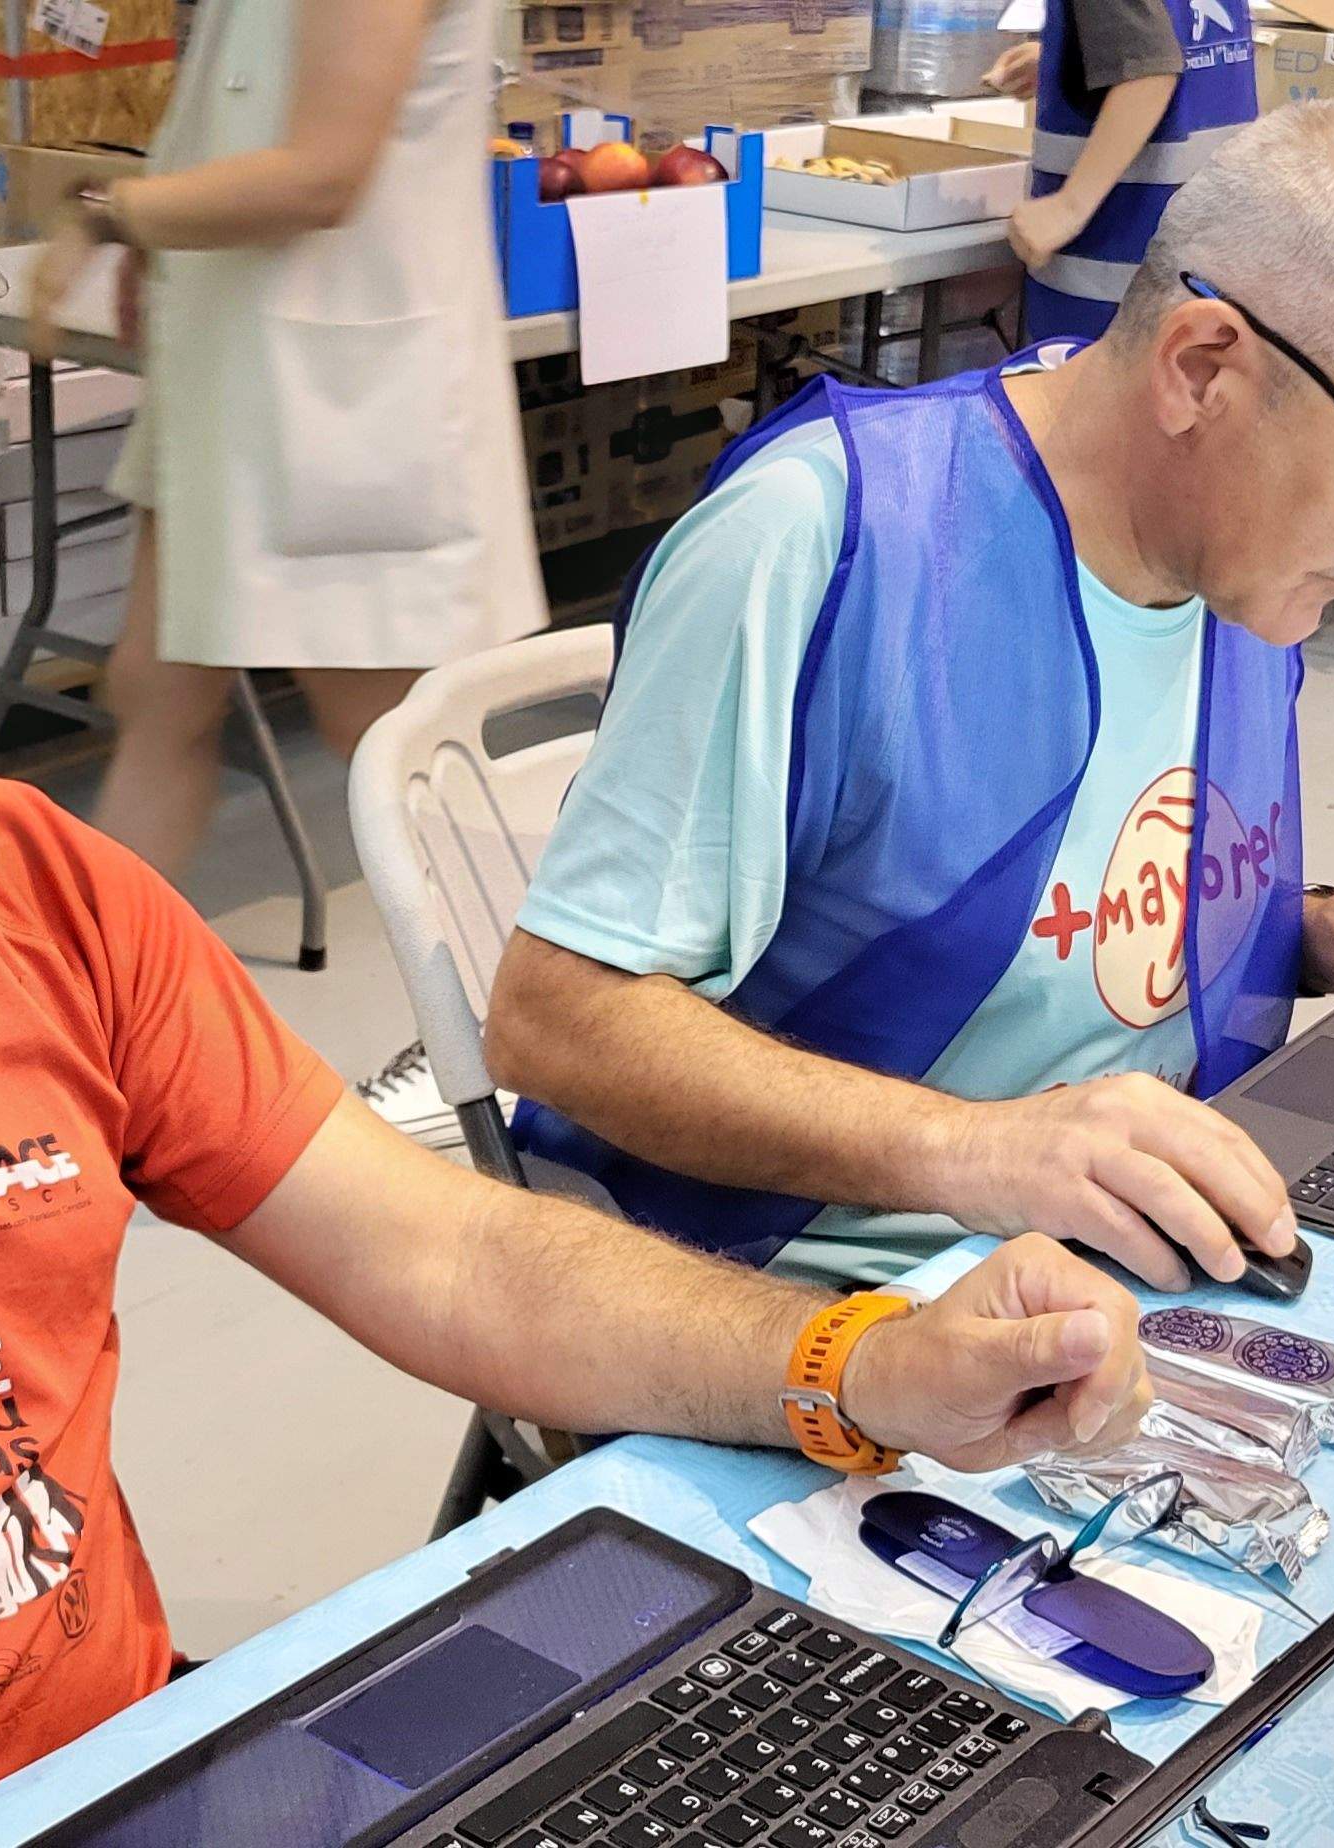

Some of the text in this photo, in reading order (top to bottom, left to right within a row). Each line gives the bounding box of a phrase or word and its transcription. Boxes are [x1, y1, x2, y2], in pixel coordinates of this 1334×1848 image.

[1164, 1324, 1197, 1339] OREO
[1269, 1350, 1302, 1366] OREO
[763, 1681, 782, 1694] Z
[824, 1691, 841, 1703] A
[728, 1706, 747, 1719] X
[876, 1708, 897, 1720] Q
[791, 1715, 809, 1728] S
[691, 1732, 710, 1744] C
[843, 1733, 865, 1748] W
[757, 1741, 775, 1754] D
[657, 1758, 675, 1770] V
[812, 1758, 830, 1772] E
[724, 1768, 740, 1781] F
[618, 1783, 638, 1796] B
[775, 1785, 795, 1798] R
[681, 1795, 701, 1809] G
[577, 1810, 599, 1824] N
[741, 1814, 759, 1827] T
[643, 1821, 666, 1836] H
